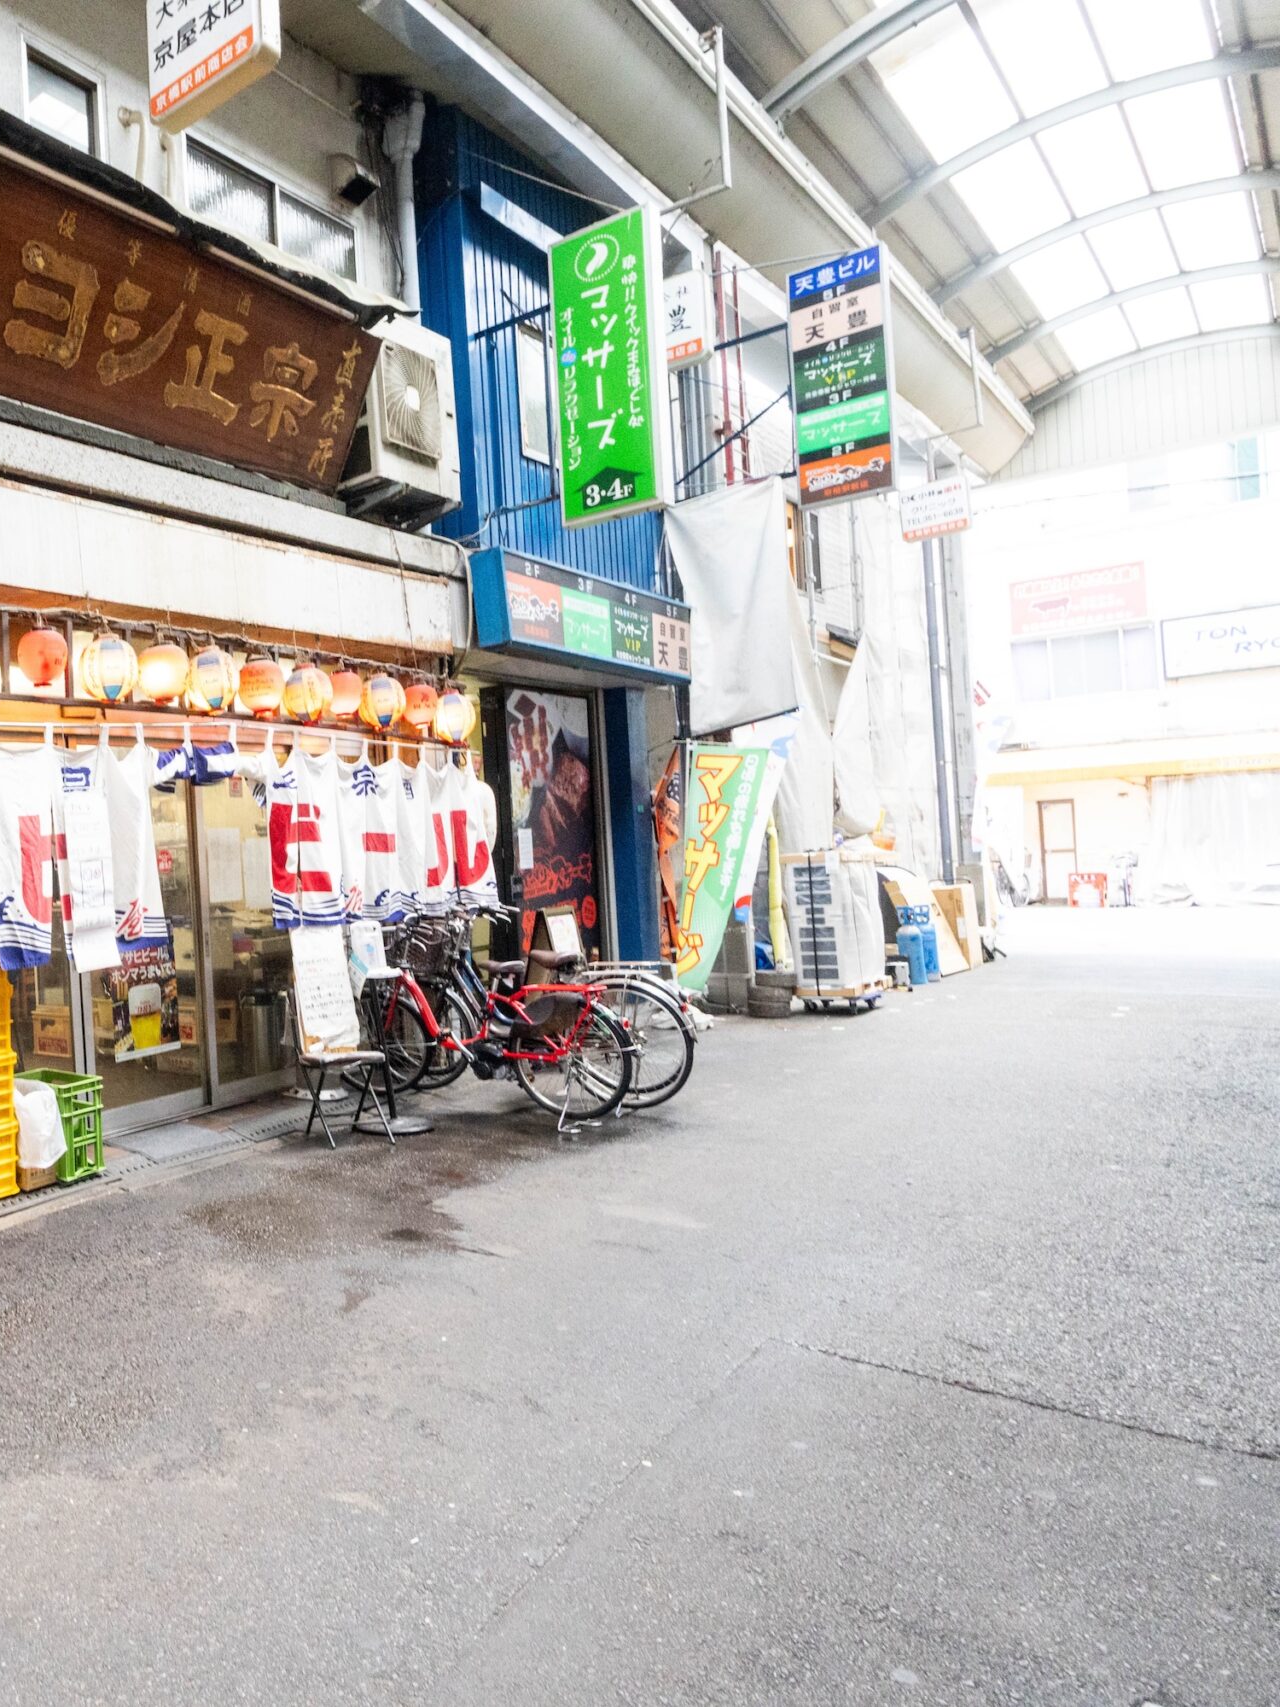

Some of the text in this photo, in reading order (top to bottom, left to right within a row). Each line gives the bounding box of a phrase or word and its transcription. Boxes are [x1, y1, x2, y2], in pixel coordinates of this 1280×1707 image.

[795, 256, 876, 296] 天豊ビル
[825, 337, 850, 352] 4F
[580, 284, 624, 450] マッサーズ
[804, 353, 873, 382] マッサーズ
[824, 369, 857, 385] VIP
[829, 389, 853, 405] 3F
[801, 410, 882, 440] マッサーズ
[525, 563, 540, 578] 2F
[578, 577, 593, 593] 3F
[624, 593, 637, 607] 4F
[666, 604, 678, 618] 5F
[614, 619, 650, 642] マッサーズ
[1194, 624, 1249, 642] TON
[625, 637, 641, 652] VIP
[351, 763, 379, 797] 宗
[268, 802, 491, 894] ビール
[676, 754, 743, 975] マッサーズ
